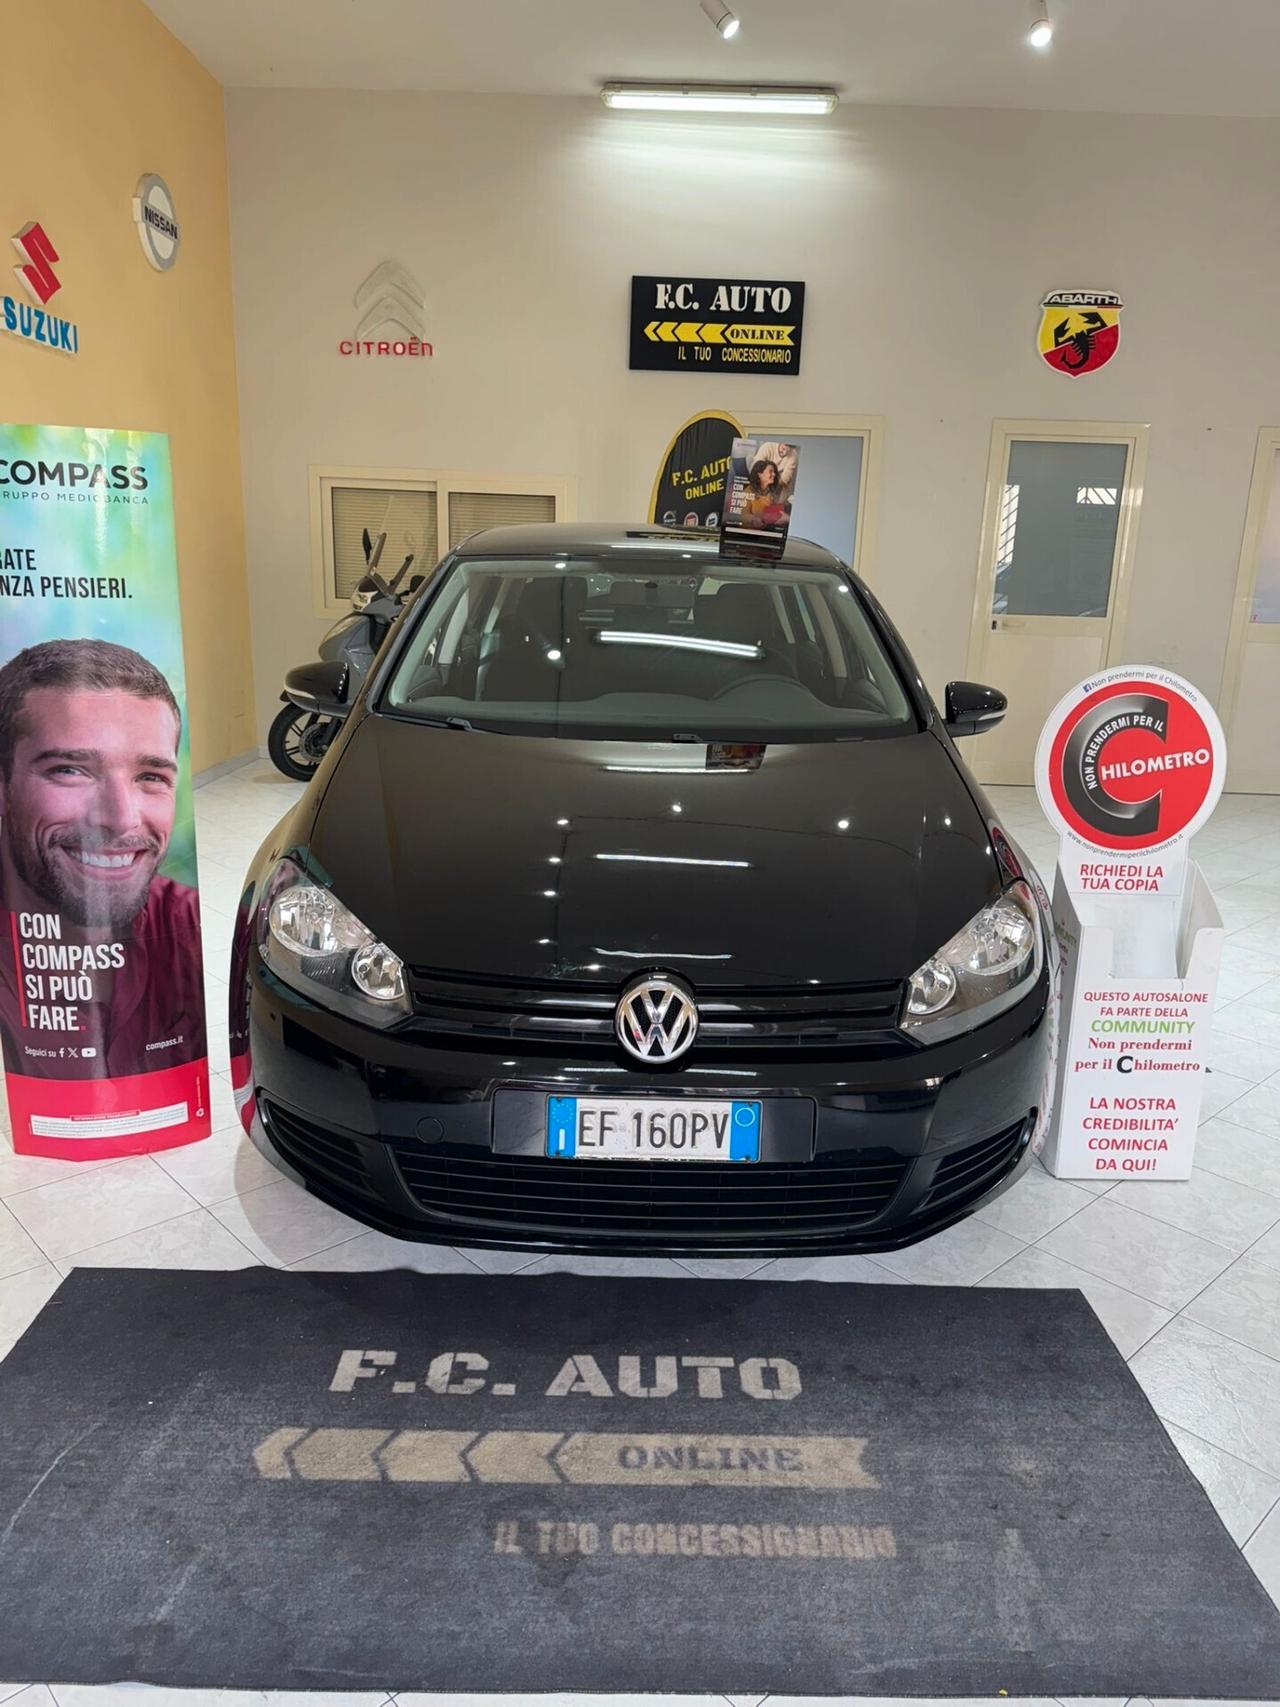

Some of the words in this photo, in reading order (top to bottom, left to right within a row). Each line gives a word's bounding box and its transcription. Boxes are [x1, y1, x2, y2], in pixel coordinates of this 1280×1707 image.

[144, 205, 178, 240] NISSAN
[654, 283, 700, 310] F.C.
[709, 285, 792, 313] AUTO
[1049, 293, 1118, 305] ABARTH
[3, 296, 78, 354] SUZUKI
[729, 327, 786, 341] ONLINE
[677, 345, 687, 361] IL
[693, 346, 712, 361] TUO
[721, 347, 792, 364] CONCESSIONARIO
[671, 469, 698, 487] F.C.
[2, 490, 50, 501] RUPPO
[685, 478, 725, 500] ONLINE
[0, 548, 37, 571] ATE
[0, 575, 35, 597] NZA
[40, 576, 133, 599] PENSIERI.
[1091, 677, 1107, 688] Non
[1107, 671, 1145, 683] prendermi
[1145, 671, 1159, 680] per
[1159, 673, 1165, 681] il
[1164, 675, 1198, 702] Chilometro
[1133, 714, 1153, 728] PER
[1153, 719, 1164, 733] IL
[1085, 715, 1130, 764] PRENDERMI
[1083, 766, 1098, 790] NON
[1080, 863, 1143, 878] RICHIEDI
[1146, 864, 1164, 878] LA
[1081, 877, 1110, 891] TUA
[1114, 878, 1160, 892] COPIA
[19, 912, 62, 940] CON
[22, 943, 126, 971] COMPASS
[25, 974, 44, 1000] SI
[50, 970, 93, 1001] PUÒ
[1083, 991, 1130, 1004] QUESTO
[1132, 992, 1209, 1003] AUTOSALONE
[1099, 1006, 1114, 1017] FA
[1116, 1006, 1152, 1018] PARTE
[1154, 1007, 1189, 1018] DELLA
[1091, 1019, 1196, 1034] COMMUNITY
[24, 1045, 48, 1058] Seguici
[47, 1050, 57, 1058] su
[145, 1035, 185, 1051] compass.it
[1087, 1037, 1116, 1050] Non
[1120, 1038, 1193, 1053] prendermi
[1074, 1059, 1099, 1072] per
[1102, 1058, 1113, 1070] il
[1116, 1055, 1200, 1074] Chilometro
[1089, 1097, 1109, 1110] LA
[1113, 1097, 1177, 1111] NOSTRA
[578, 1109, 619, 1148] EF
[631, 1111, 730, 1149] 160PV
[1087, 1137, 1169, 1151] COMINCIA
[1095, 1158, 1118, 1171] DA
[1121, 1158, 1157, 1172] QUI!
[329, 1350, 516, 1395] F.C.
[545, 1354, 802, 1401] AUTO
[617, 1445, 802, 1472] ONLINE
[493, 1520, 522, 1554] IL
[535, 1521, 600, 1555] TUO
